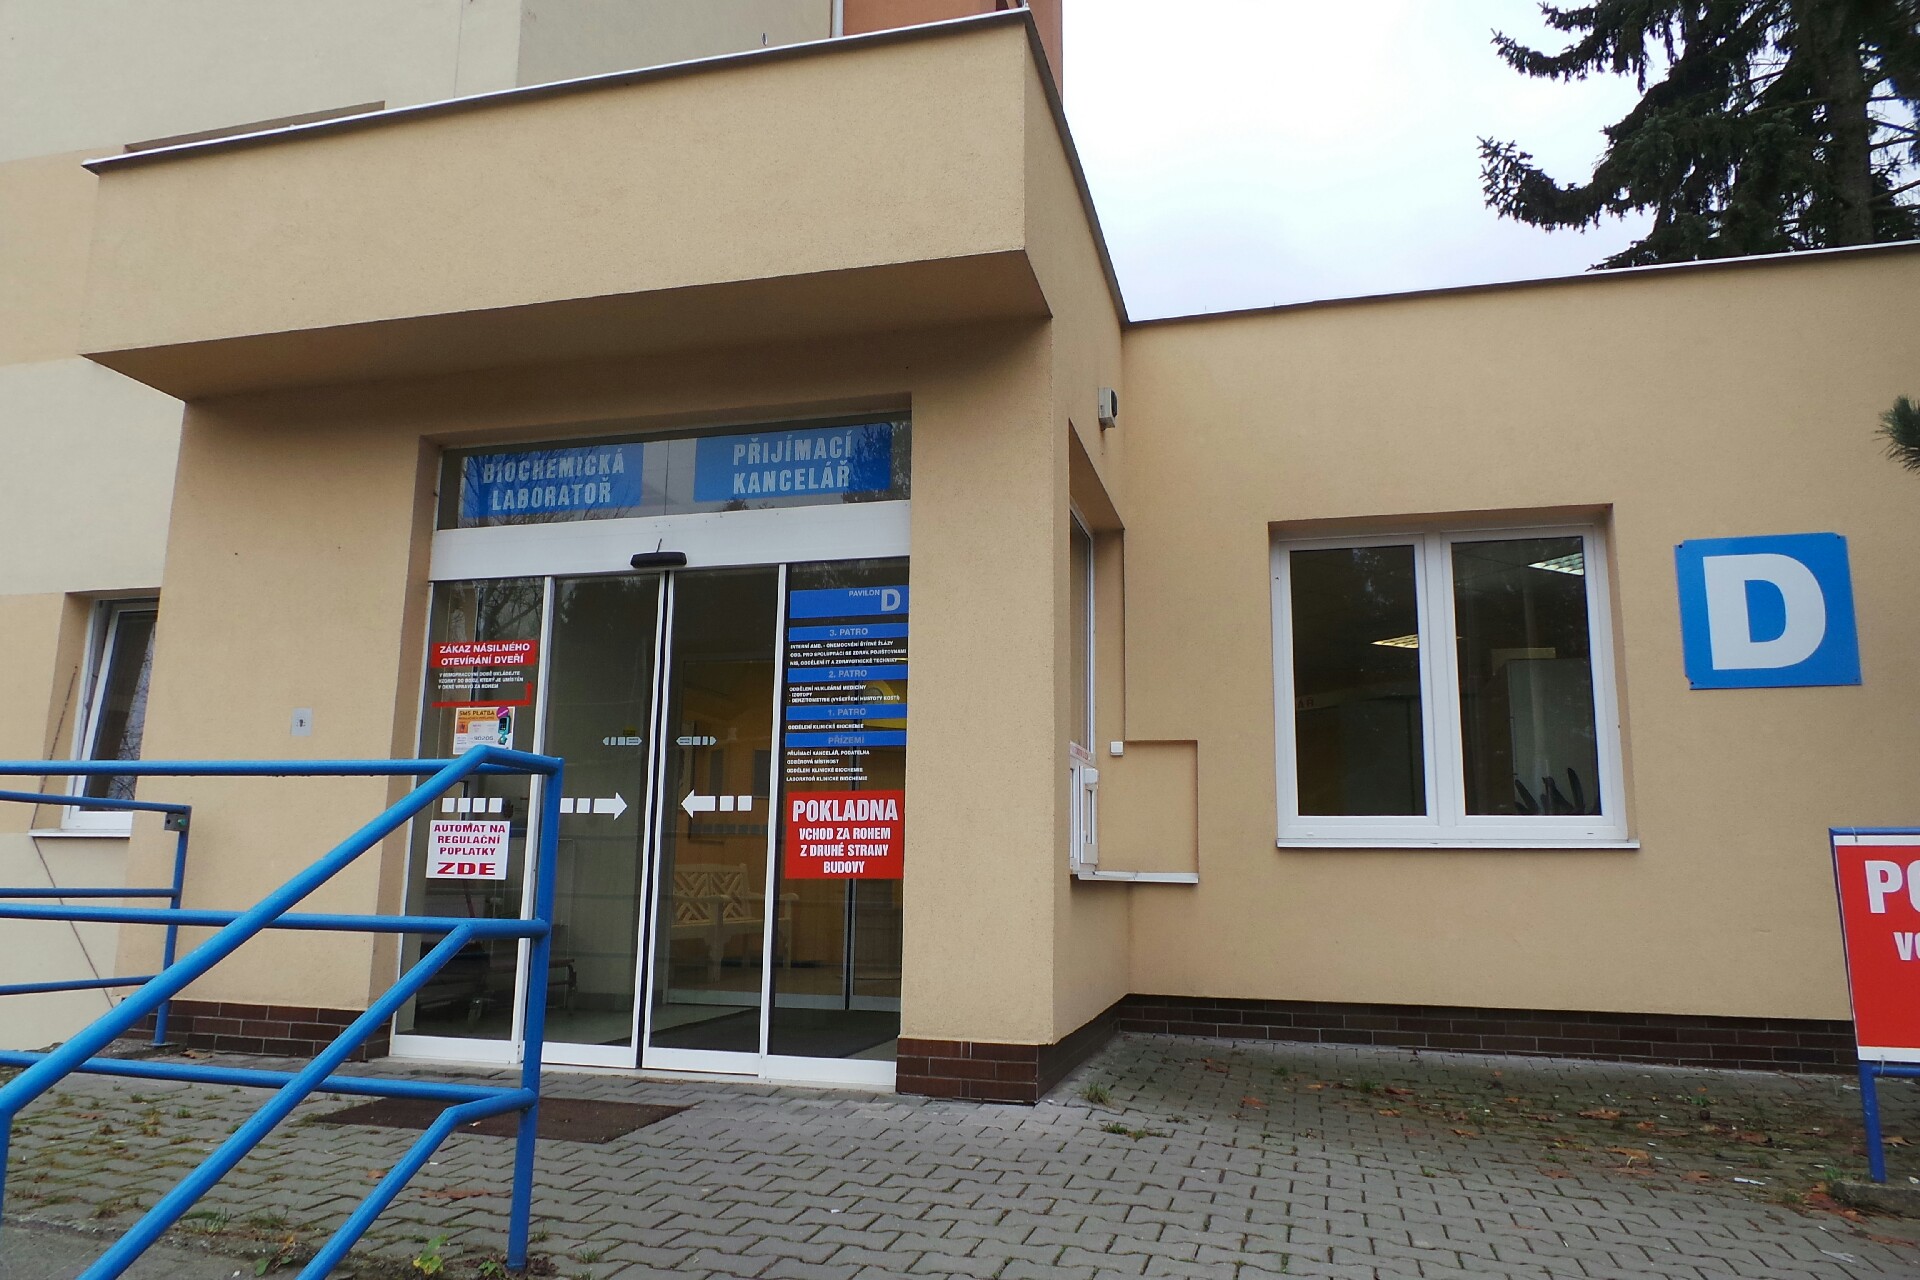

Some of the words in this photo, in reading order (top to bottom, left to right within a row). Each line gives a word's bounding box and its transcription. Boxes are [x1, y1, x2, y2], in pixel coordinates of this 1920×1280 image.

[733, 430, 852, 466] PŘIJÍMACÍ
[483, 448, 624, 484] BIOCHEMICKÁ
[733, 460, 850, 494] KANCELÁŘ
[492, 477, 611, 511] LABORATOŘ
[848, 589, 880, 597] PAVILON
[881, 588, 900, 611] D
[1702, 552, 1827, 670] D
[840, 628, 868, 636] PATRO
[440, 644, 471, 654] ZÁKAZ
[473, 642, 530, 653] NÁSILNÉHO
[441, 654, 492, 666] OTEVÍRÁNÍ
[494, 653, 524, 664] DVEŘÍ
[828, 670, 836, 678] 2.
[838, 669, 867, 677] PATRO
[838, 708, 866, 716] PATRO
[828, 735, 864, 744] PŘÍZEMÍ
[792, 799, 898, 822] POKLADNA
[434, 824, 486, 832] AUTOMAT
[489, 824, 506, 833] NA
[799, 827, 833, 840] VCHOD
[836, 827, 850, 840] ZA
[852, 827, 891, 840] ROHEM
[437, 834, 501, 844] REGULAČNÍ
[440, 847, 496, 856] POPLATKY
[800, 844, 808, 857] Z
[809, 842, 844, 857] DRUHÉ
[847, 844, 889, 857] STRANY
[437, 862, 496, 876] ZDE
[823, 860, 865, 874] BUDOVY
